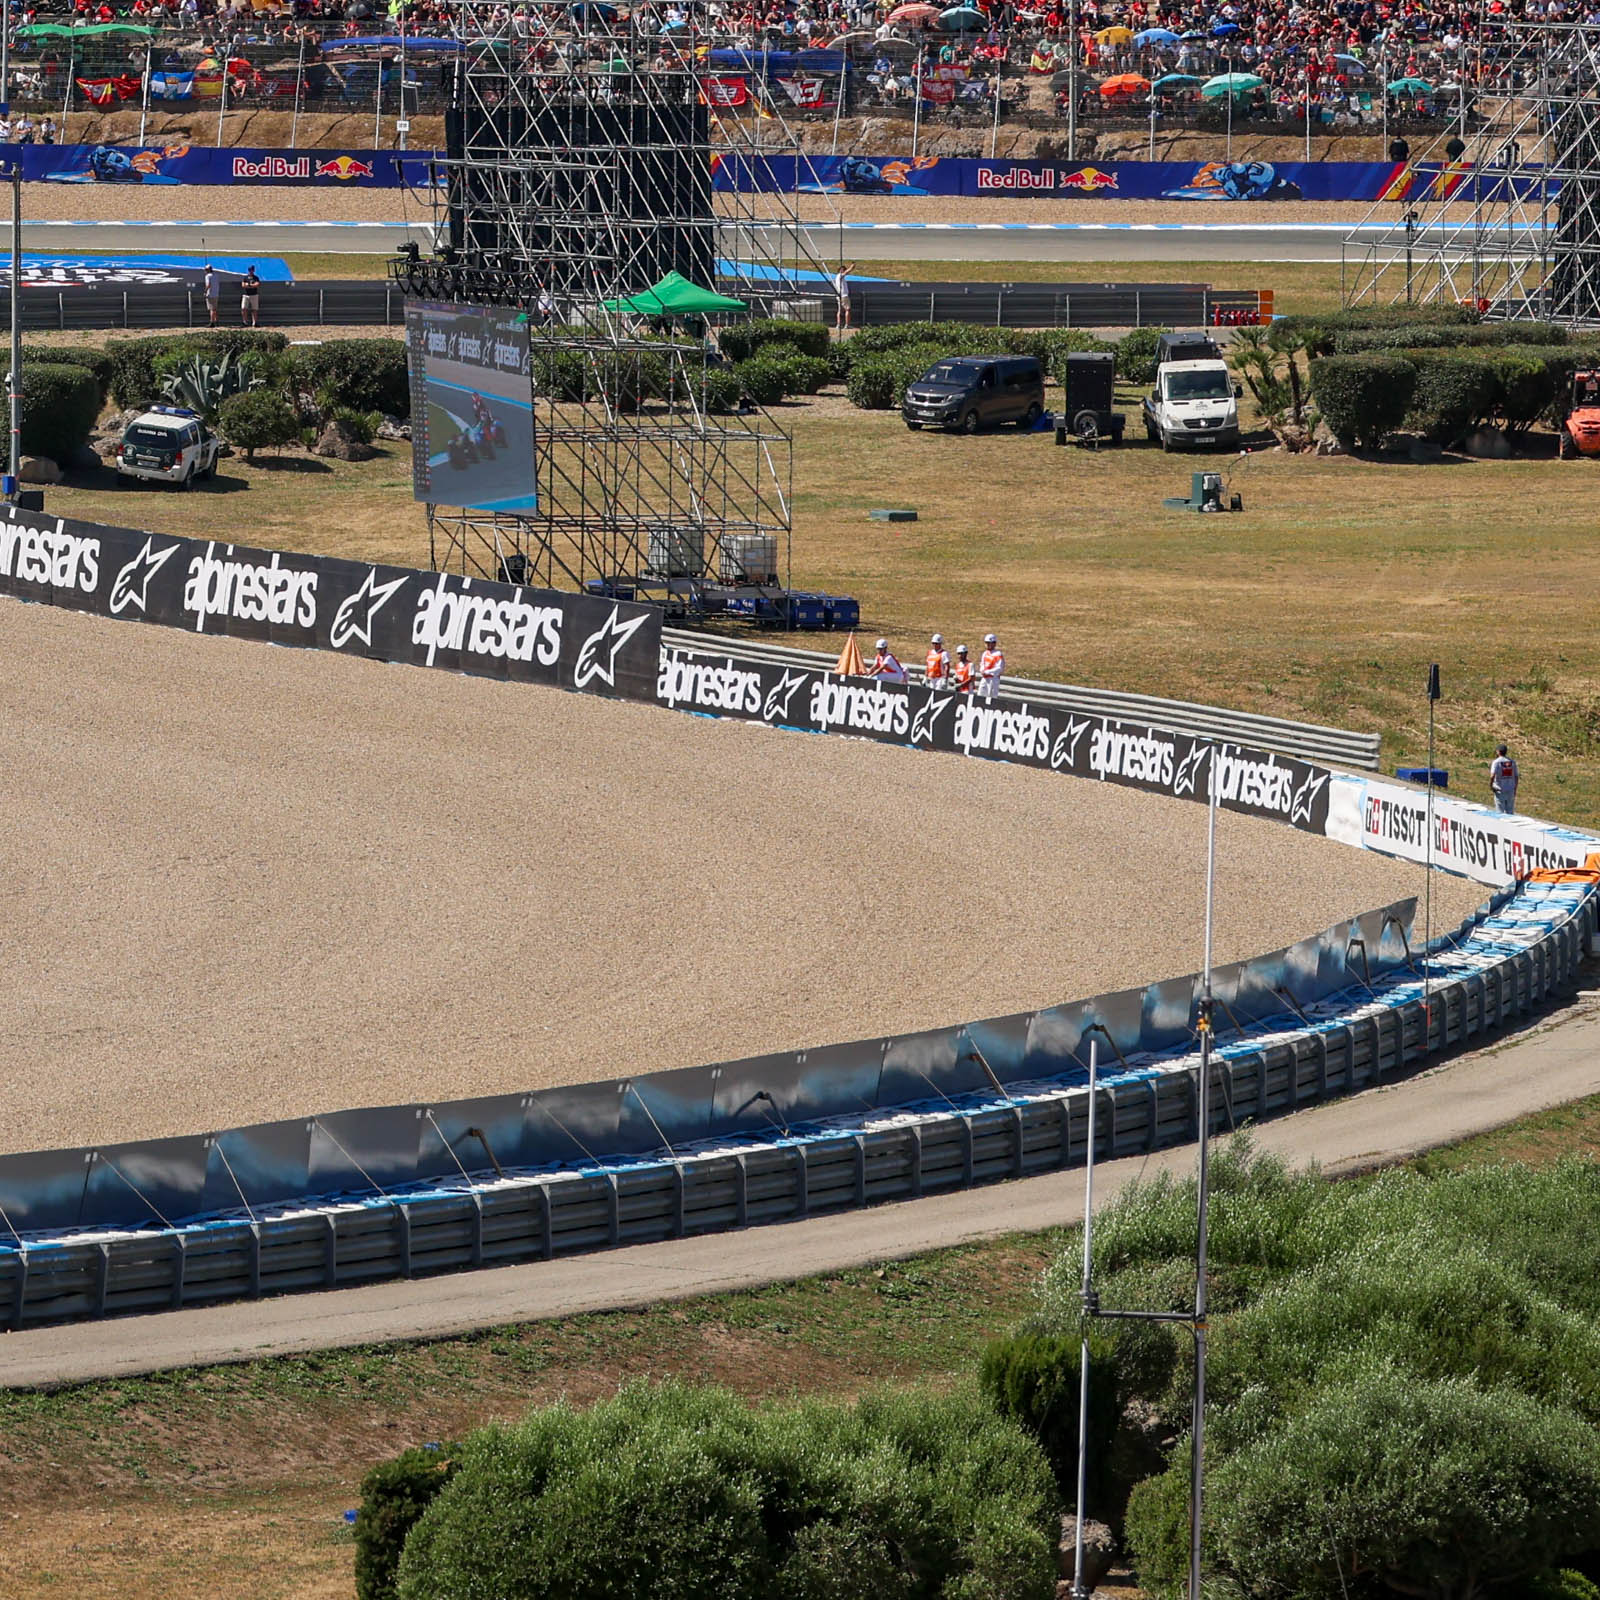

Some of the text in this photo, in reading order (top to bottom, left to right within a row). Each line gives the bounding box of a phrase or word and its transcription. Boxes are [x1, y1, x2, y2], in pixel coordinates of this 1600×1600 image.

[233, 157, 309, 177] Red Bull
[978, 168, 1054, 189] Red Bull
[184, 539, 317, 632] alpinestars
[412, 572, 562, 666] alpinestars
[657, 650, 761, 712] alpinestars
[810, 670, 908, 735] alpinestars
[954, 696, 1049, 759] alpinestars
[1090, 719, 1174, 784] alpinestars
[1382, 800, 1425, 846] TISSOT
[1450, 820, 1498, 870] TISSOT
